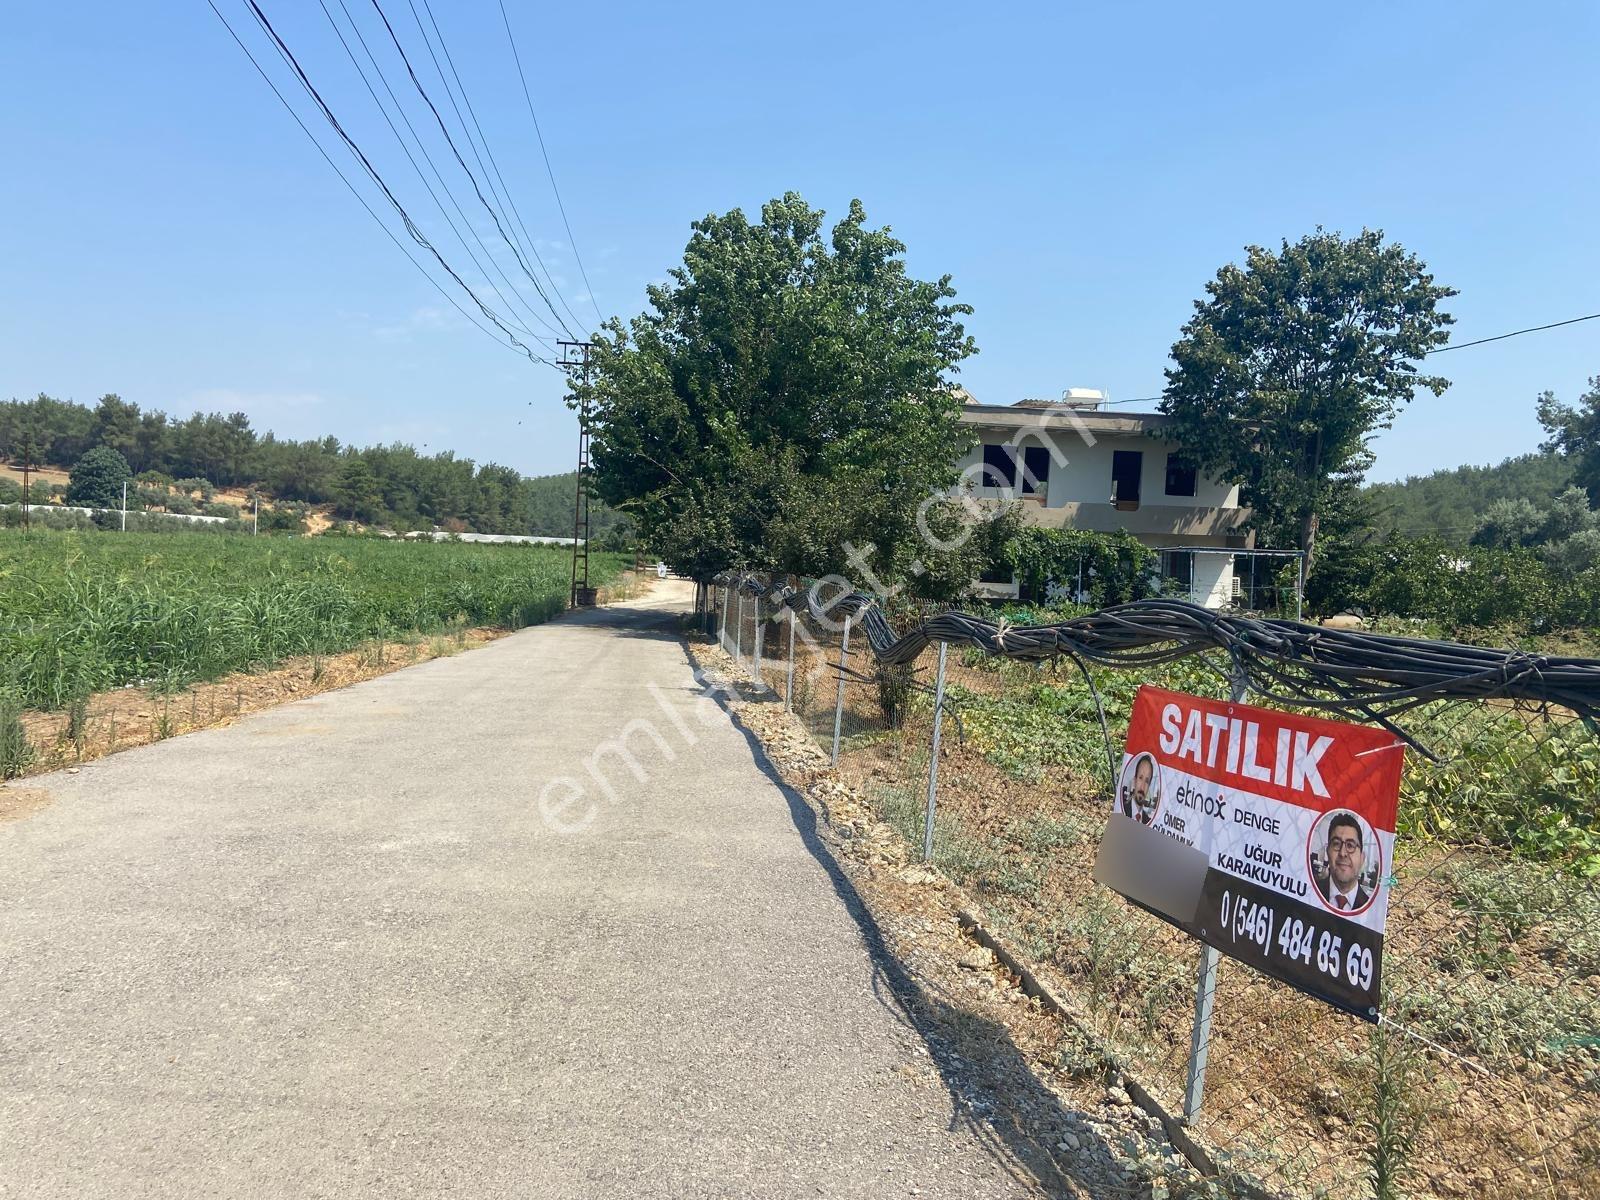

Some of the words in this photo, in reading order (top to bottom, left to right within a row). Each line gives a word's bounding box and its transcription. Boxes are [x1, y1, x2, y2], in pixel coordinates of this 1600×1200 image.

[1164, 810, 1186, 833] ÖMER
[1234, 808, 1280, 835] DENGE
[1244, 843, 1282, 869] UĞUR
[1217, 852, 1307, 897] KARAKUYULU
[1220, 890, 1230, 928] 0
[1232, 894, 1274, 956] (546)
[1278, 916, 1315, 965] 484
[1317, 930, 1342, 978] 85
[1346, 942, 1373, 991] 69
